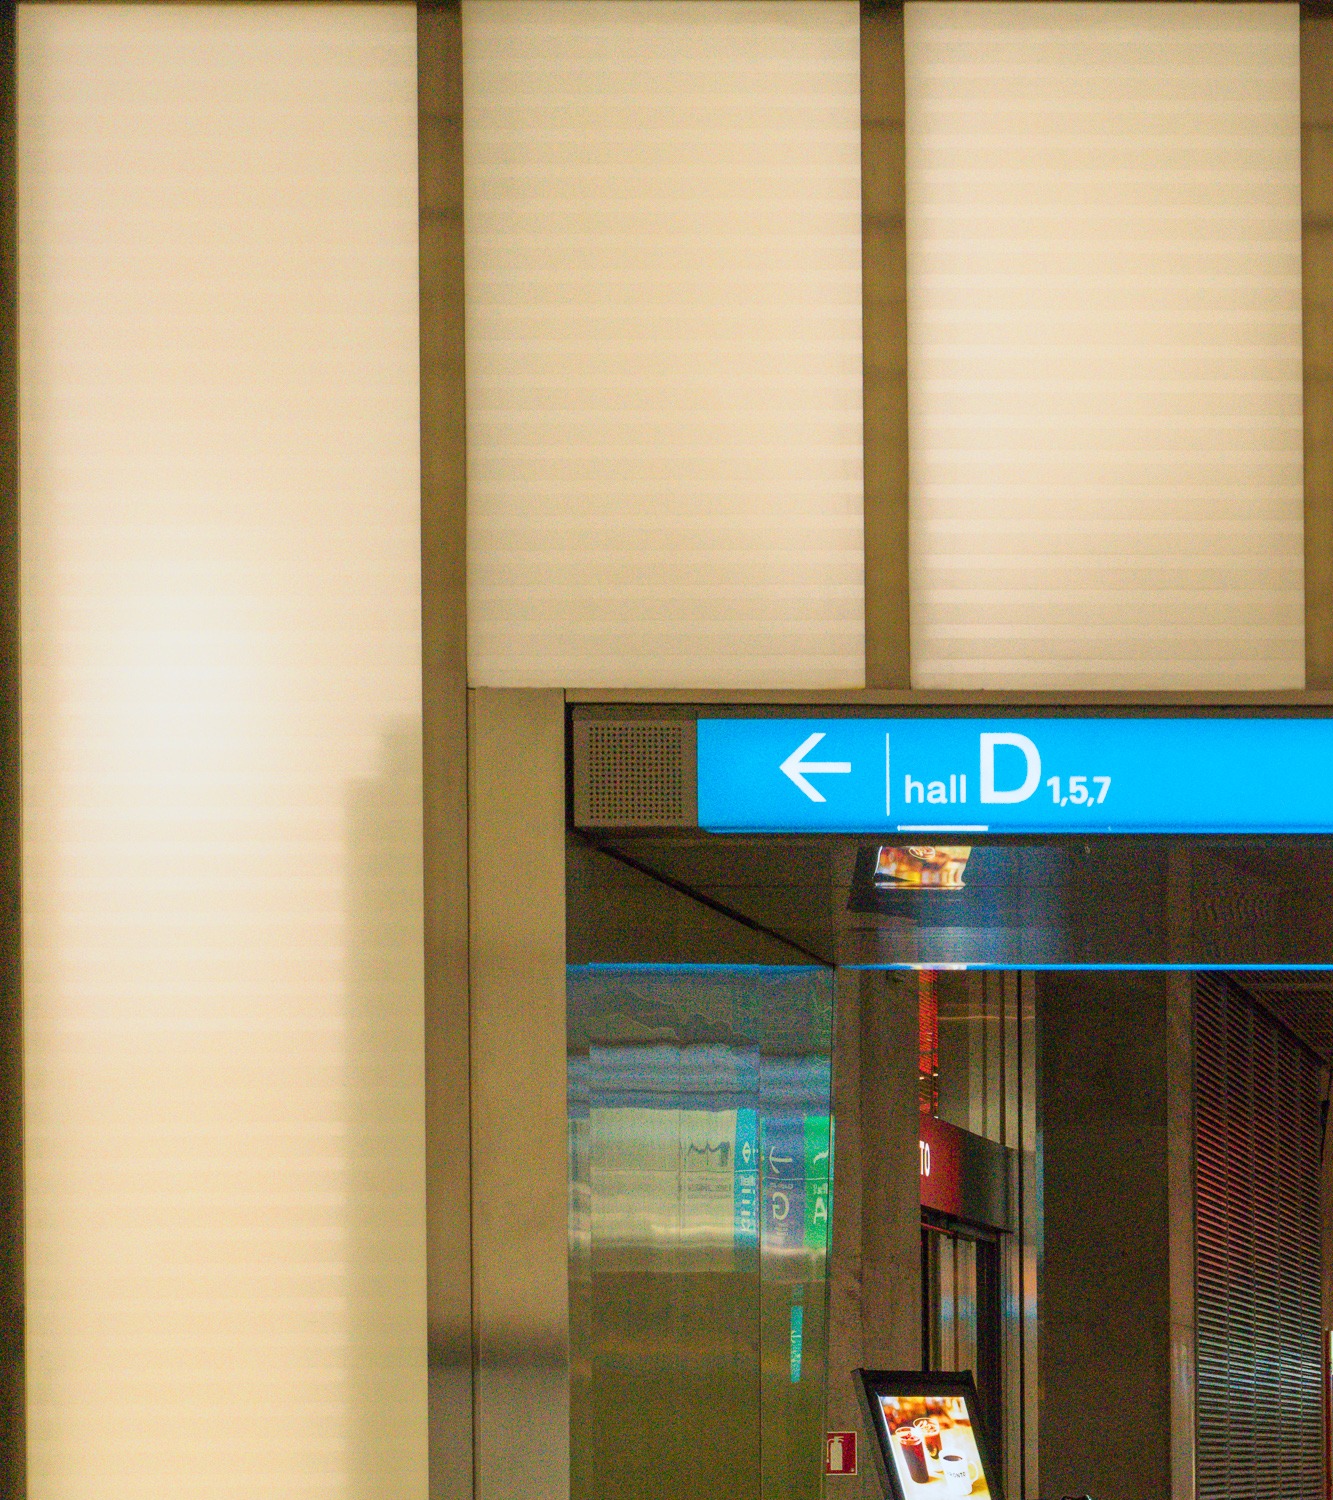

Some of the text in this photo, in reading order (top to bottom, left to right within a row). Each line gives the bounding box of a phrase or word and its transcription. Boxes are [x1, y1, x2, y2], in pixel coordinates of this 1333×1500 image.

[904, 732, 1112, 807] hall D 1,5,7
